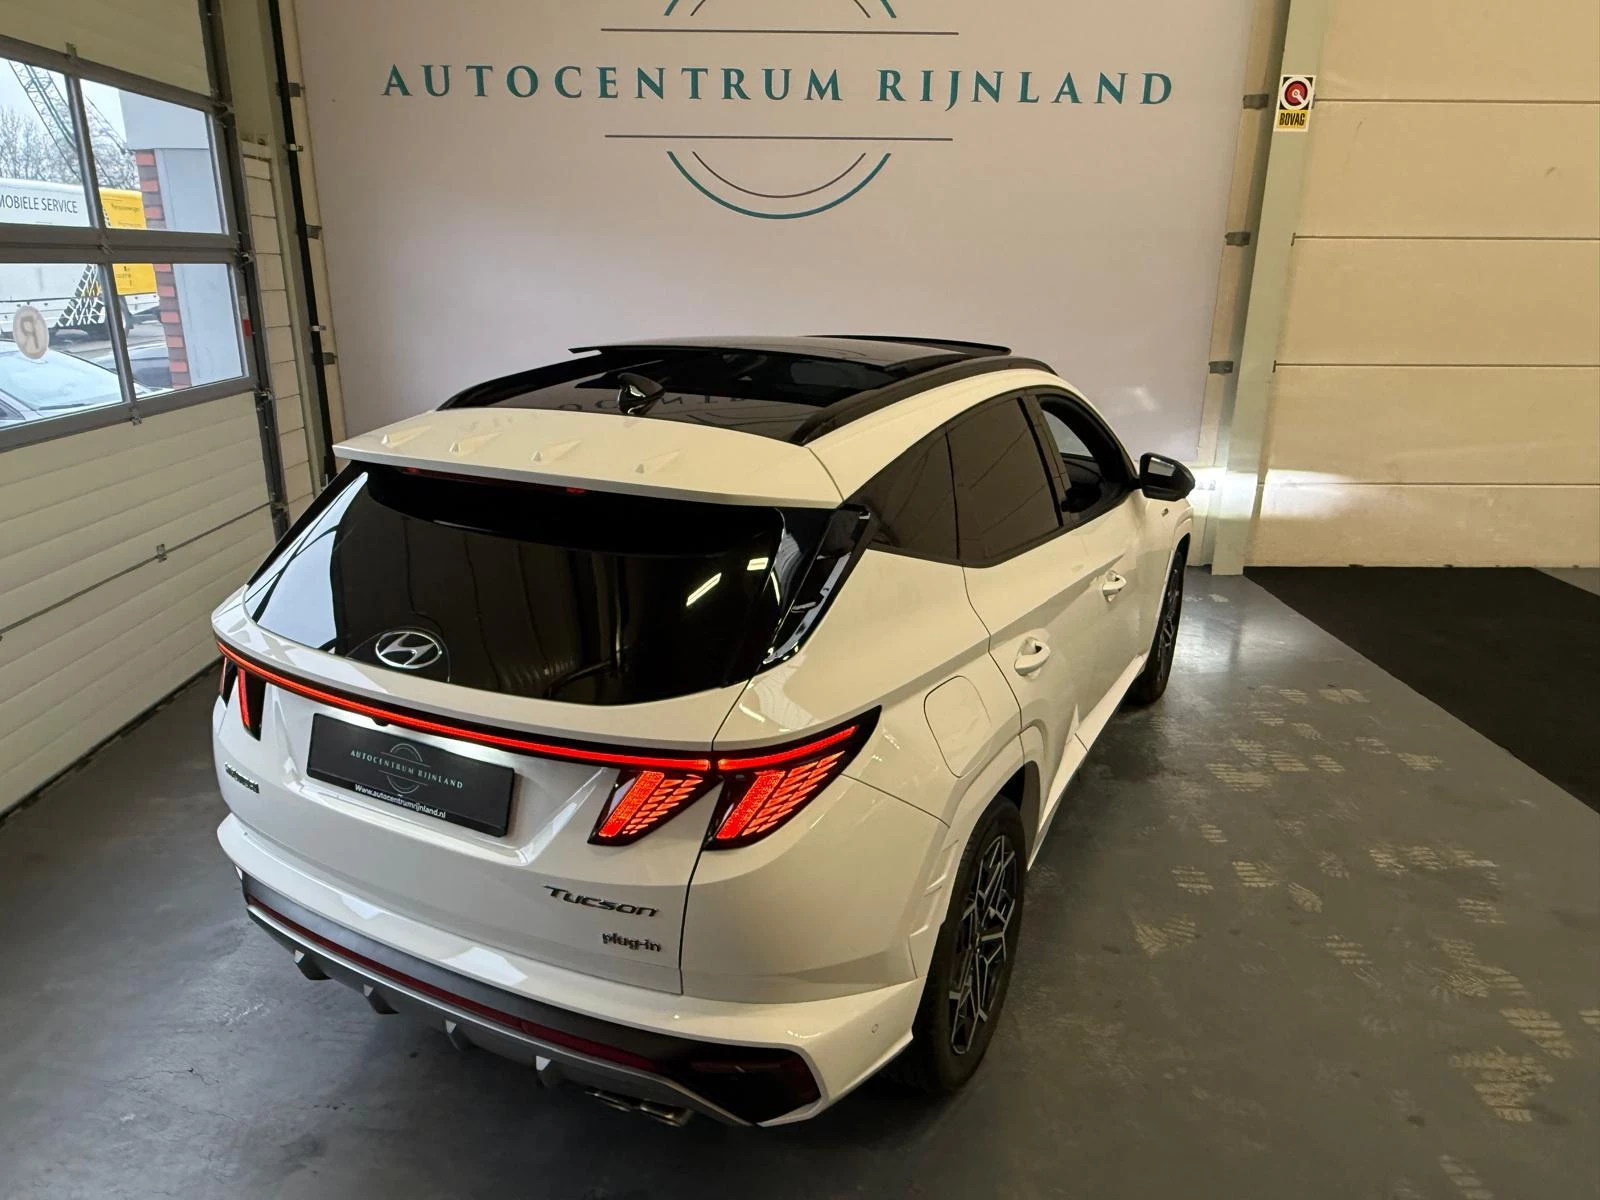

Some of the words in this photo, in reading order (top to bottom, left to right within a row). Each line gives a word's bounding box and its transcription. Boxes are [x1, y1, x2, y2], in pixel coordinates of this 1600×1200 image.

[380, 63, 843, 102] AUTOCENTRUM
[876, 69, 1173, 112] RIJNLAND
[1278, 112, 1306, 127] BOVAG
[41, 197, 78, 214] SERVICE
[350, 749, 415, 775] AUTOCENTRUM
[417, 768, 464, 789] RIJNLAND
[601, 932, 662, 953] plug-in
